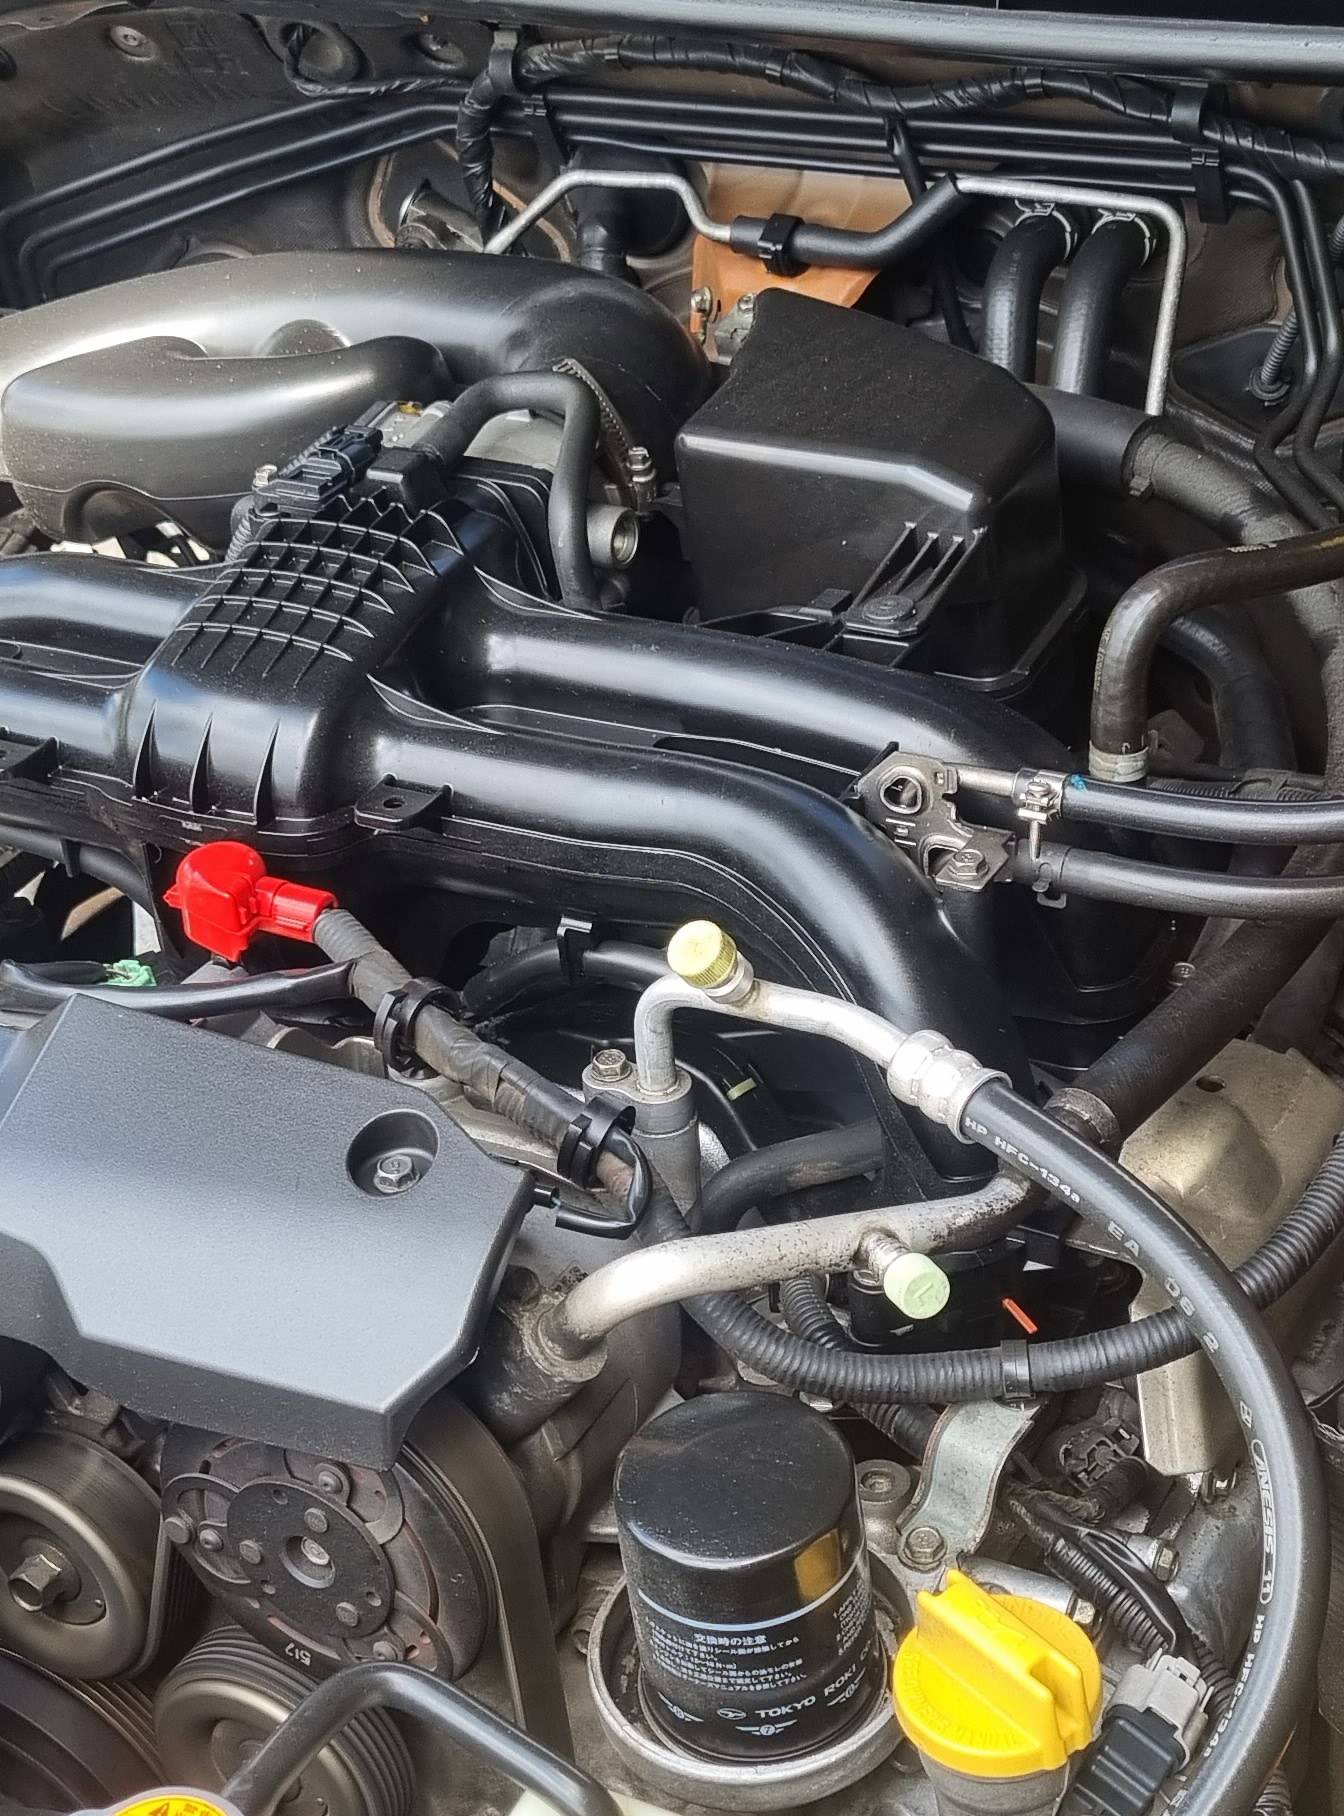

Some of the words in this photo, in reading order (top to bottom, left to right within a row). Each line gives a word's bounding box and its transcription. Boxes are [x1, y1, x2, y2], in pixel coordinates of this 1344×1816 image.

[964, 1116, 988, 1136] HP
[994, 1135, 1081, 1204] HFC-134a
[755, 1695, 818, 1719] TOKYO
[823, 1663, 856, 1698] ROKI
